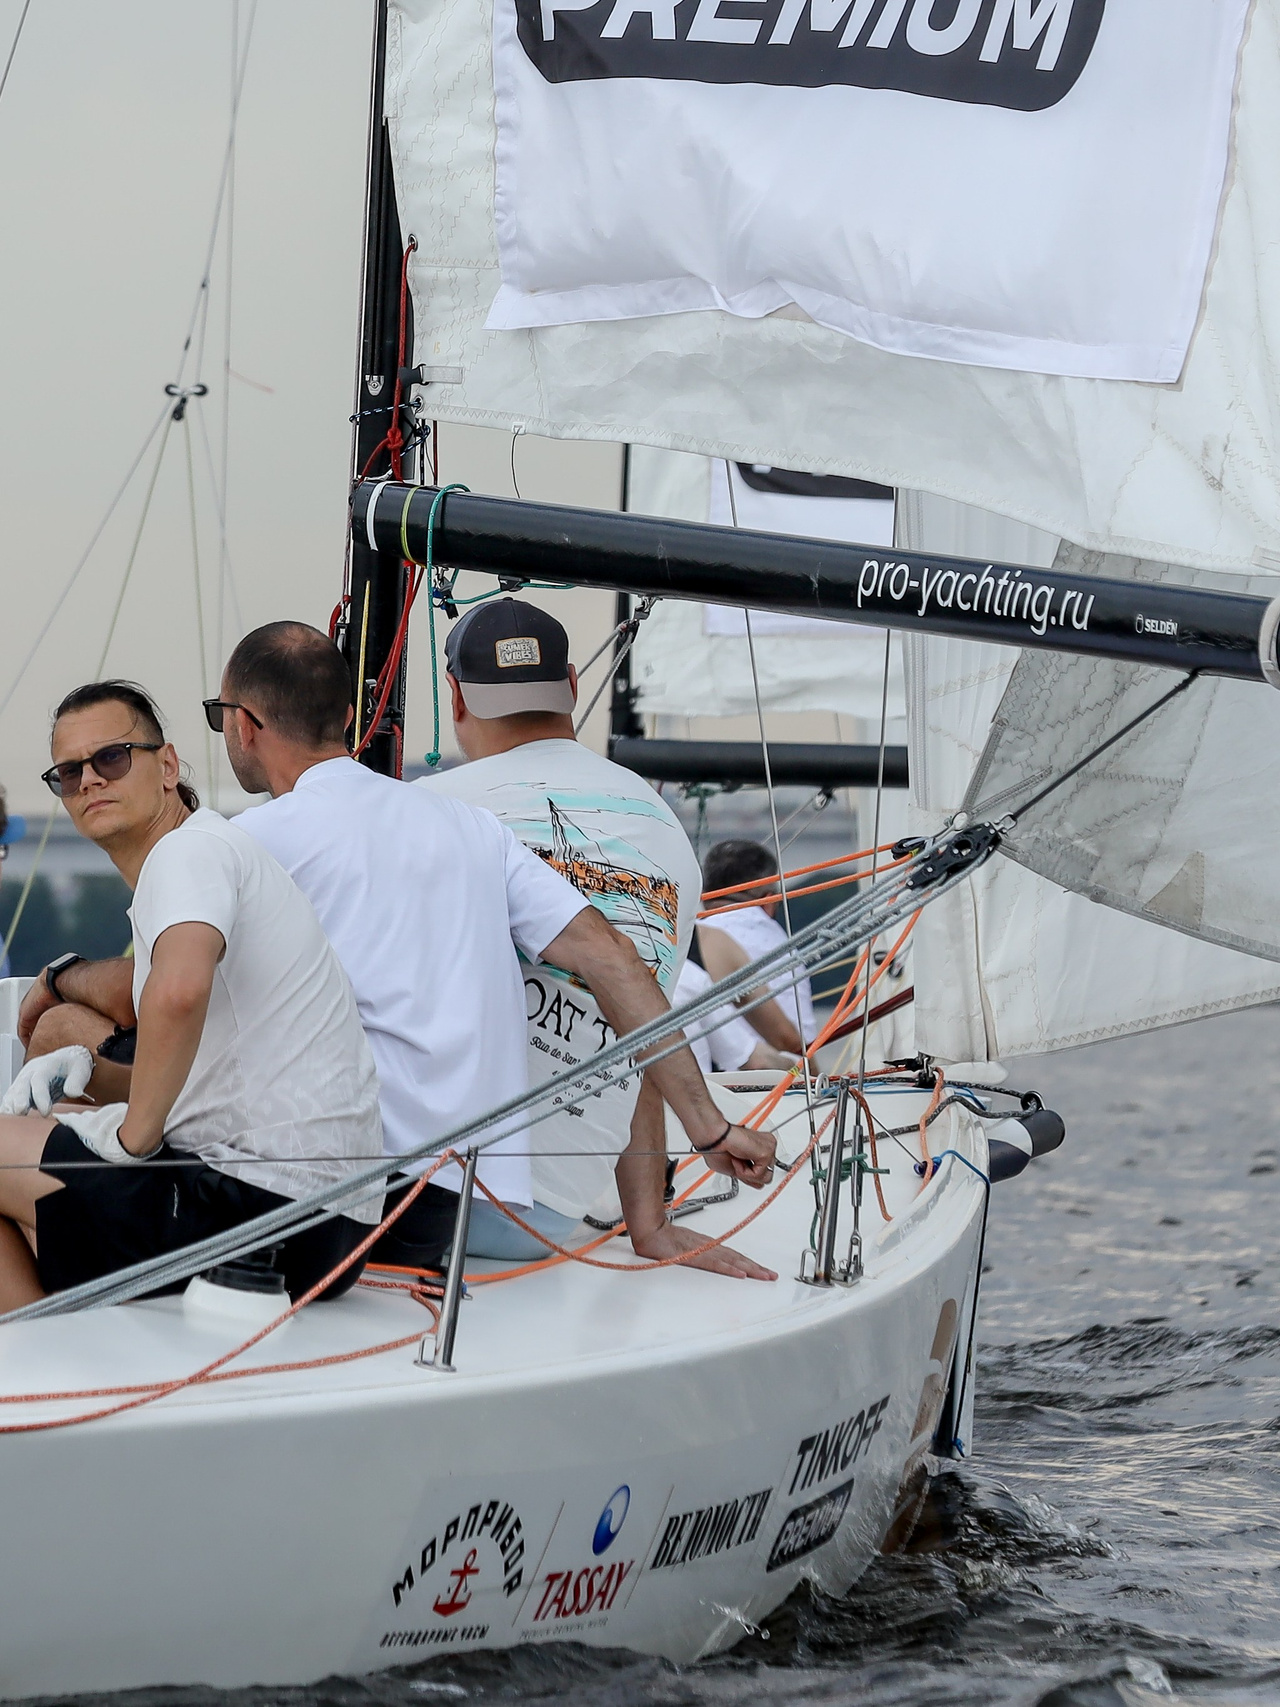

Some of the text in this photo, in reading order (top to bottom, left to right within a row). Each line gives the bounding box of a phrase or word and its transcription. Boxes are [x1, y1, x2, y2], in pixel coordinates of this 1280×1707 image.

[857, 559, 1095, 636] pro-yachting.ru
[788, 1394, 891, 1497] TINKOFF
[392, 1500, 526, 1609] МОРПРИБОР
[650, 1487, 774, 1572] ВЕДОМОСТИ
[533, 1558, 636, 1623] TASSAY
